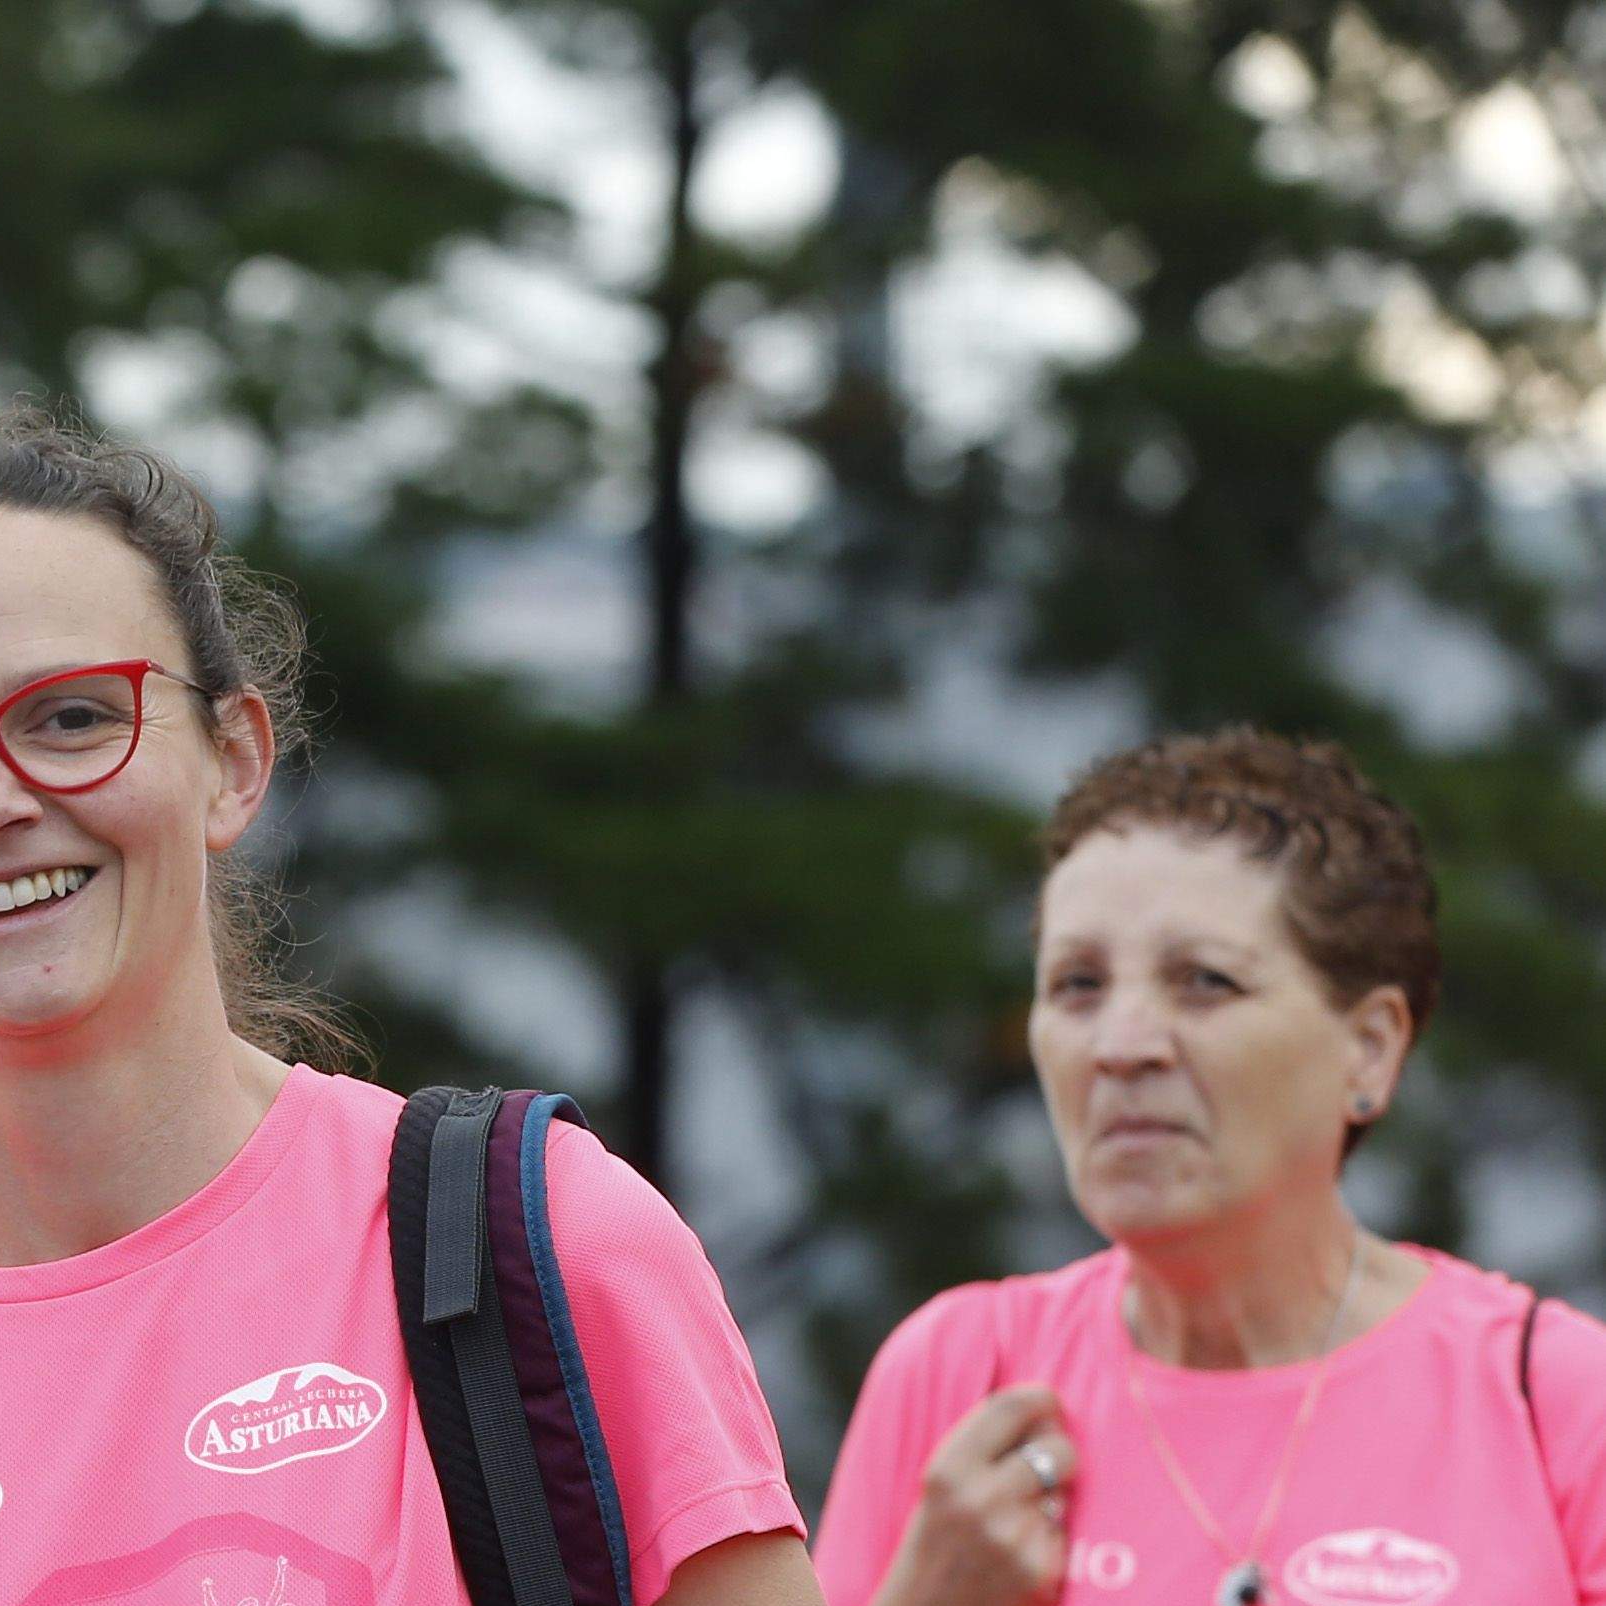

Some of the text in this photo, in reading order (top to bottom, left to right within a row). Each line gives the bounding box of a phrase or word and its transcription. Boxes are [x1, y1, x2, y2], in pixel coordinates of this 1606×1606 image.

[230, 1388, 365, 1424] CENTRAL LECHERA
[199, 1401, 374, 1458] ASTURIANA
